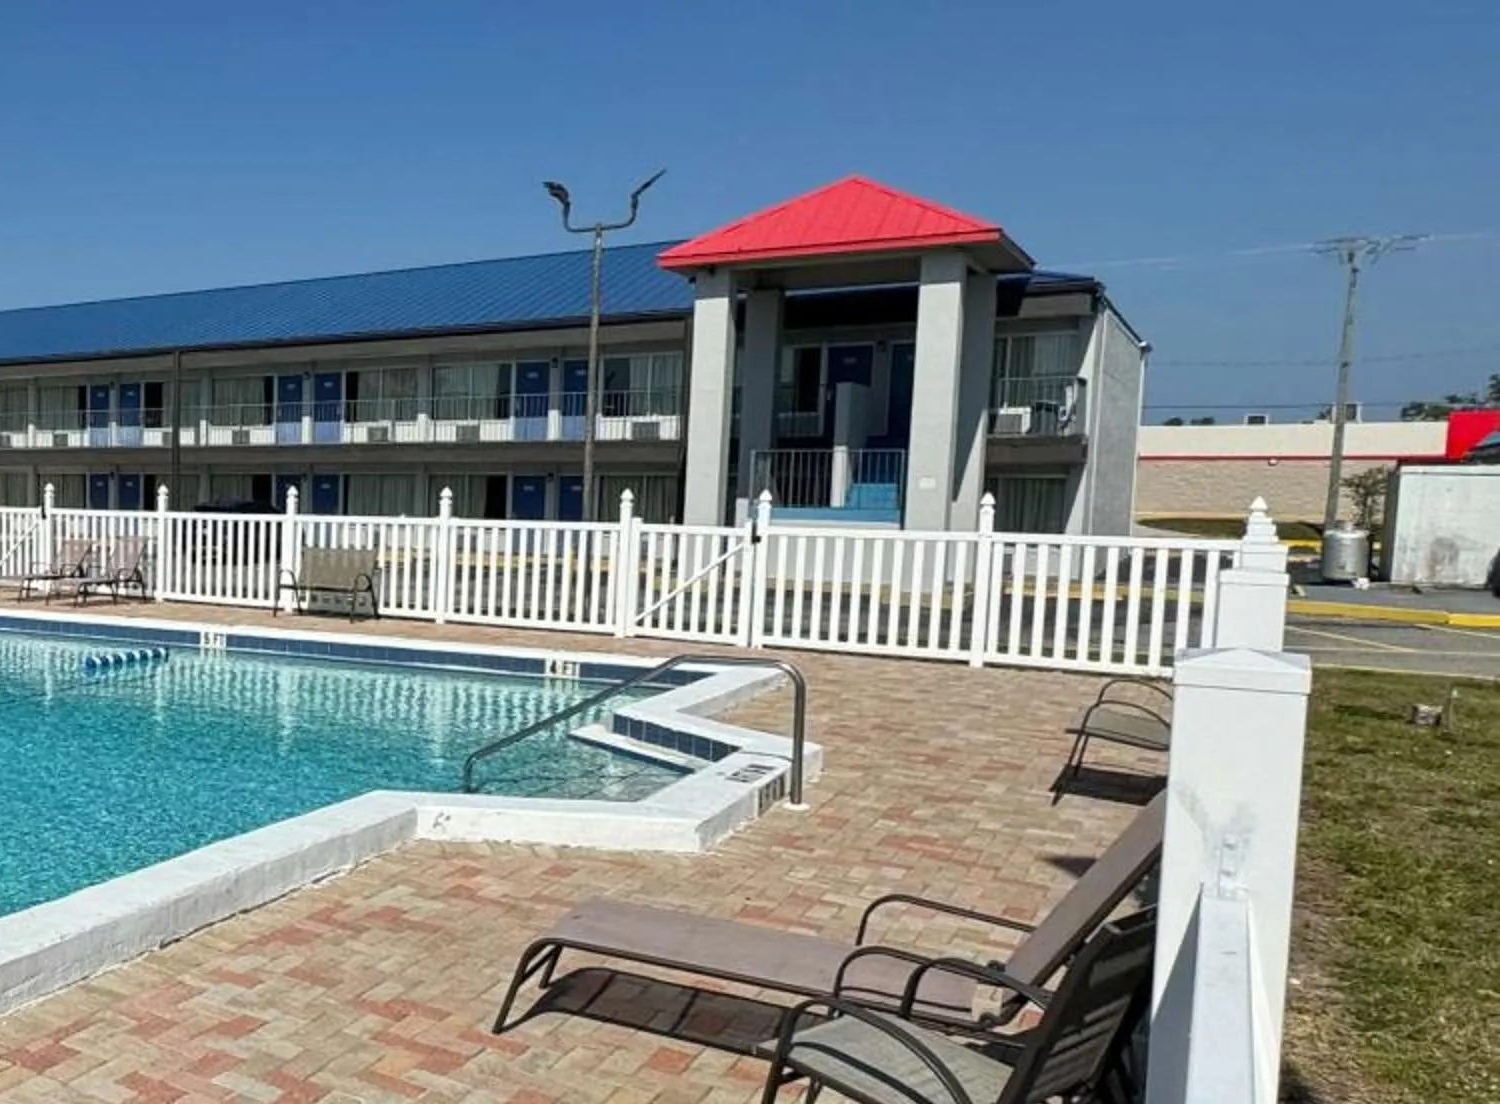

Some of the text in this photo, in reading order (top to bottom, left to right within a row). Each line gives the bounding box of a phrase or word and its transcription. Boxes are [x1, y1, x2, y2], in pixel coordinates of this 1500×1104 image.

[213, 633, 225, 646] FT
[550, 659, 577, 676] 4 FT
